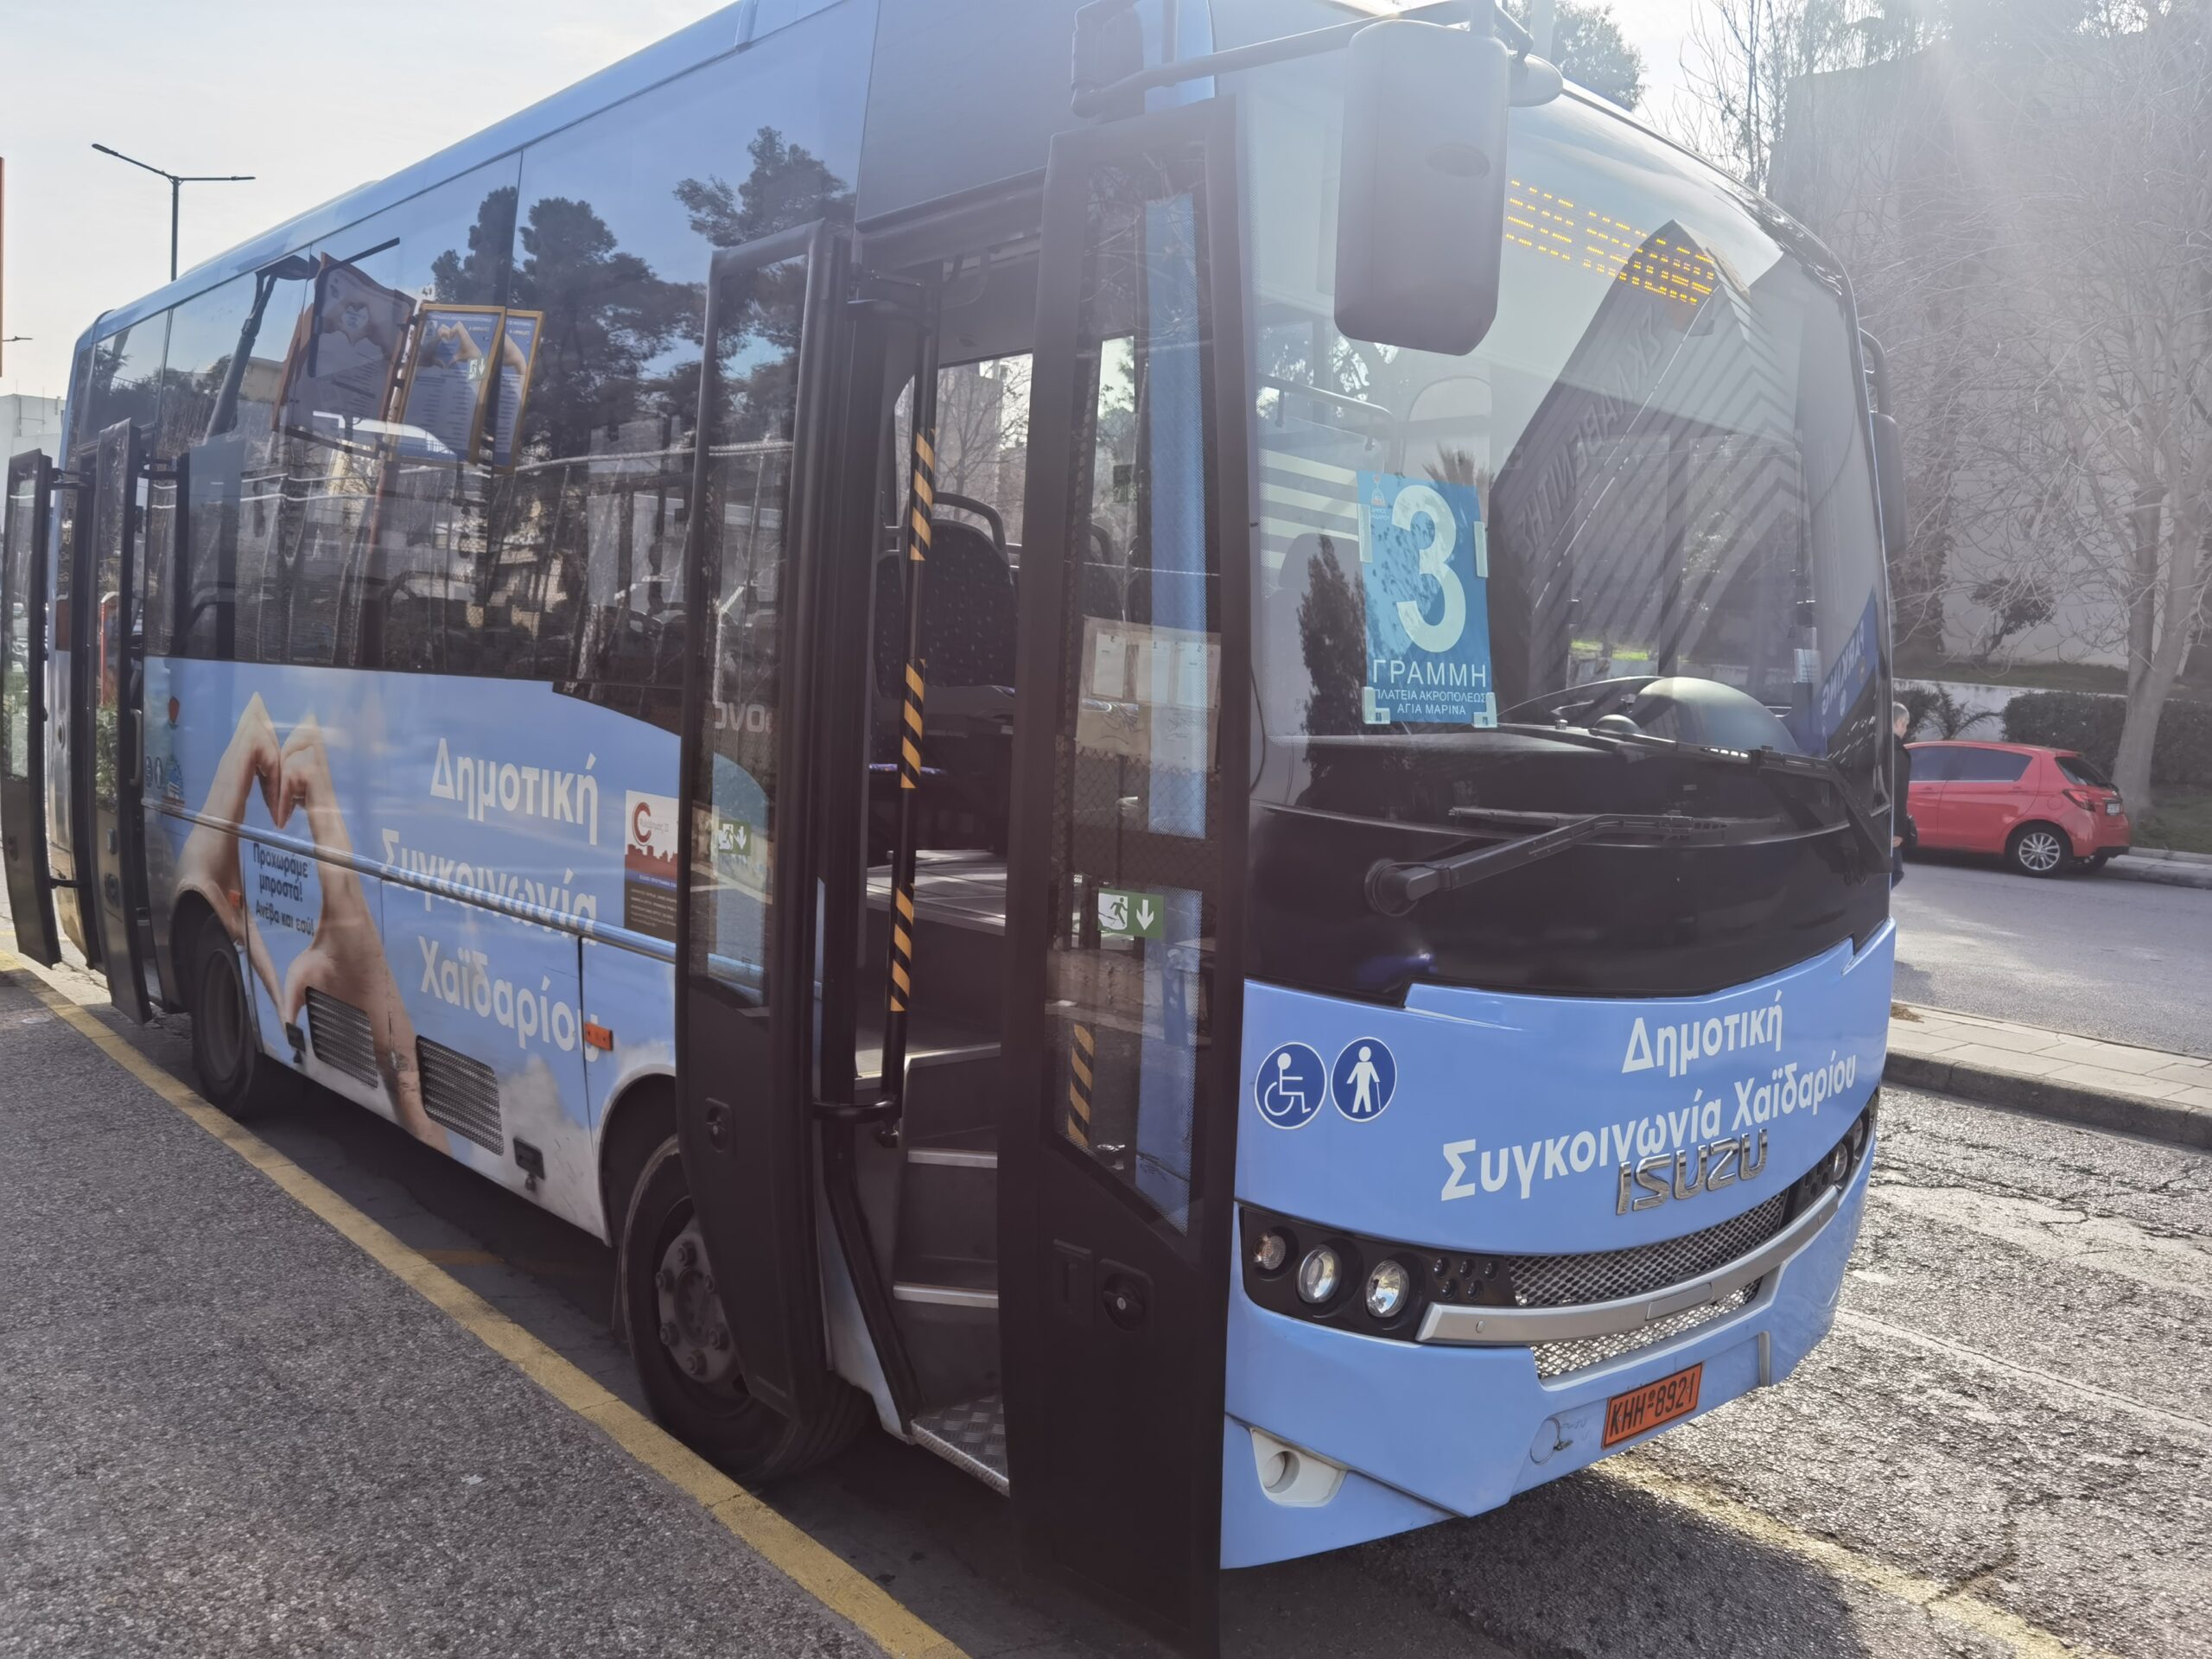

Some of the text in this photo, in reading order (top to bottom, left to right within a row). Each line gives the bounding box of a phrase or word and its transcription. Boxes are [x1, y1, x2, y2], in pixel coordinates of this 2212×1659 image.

[1391, 485, 1466, 652] 3
[1372, 659, 1486, 688] ΓΡΑΜΜΗ
[1374, 689, 1486, 703] ΠΛΑΤΕΙΑ ΑΚΡΟΠΟΛΕΩΣ
[1396, 702, 1466, 715] ΑΓΙΑ ΜΑΡΙΝΑ
[430, 738, 598, 845] Δημοτική
[253, 842, 308, 880] Προχωράμε
[259, 874, 303, 902] μπροστά!
[381, 828, 596, 946] Συγκοινωνία
[256, 899, 315, 937] Ανέβα και εσύ!
[1622, 989, 1783, 1077] Δημοτική
[1441, 1050, 1857, 1201] Συγκοινωνία Χαϊδαρίου
[1615, 1128, 1768, 1216] ISUZU
